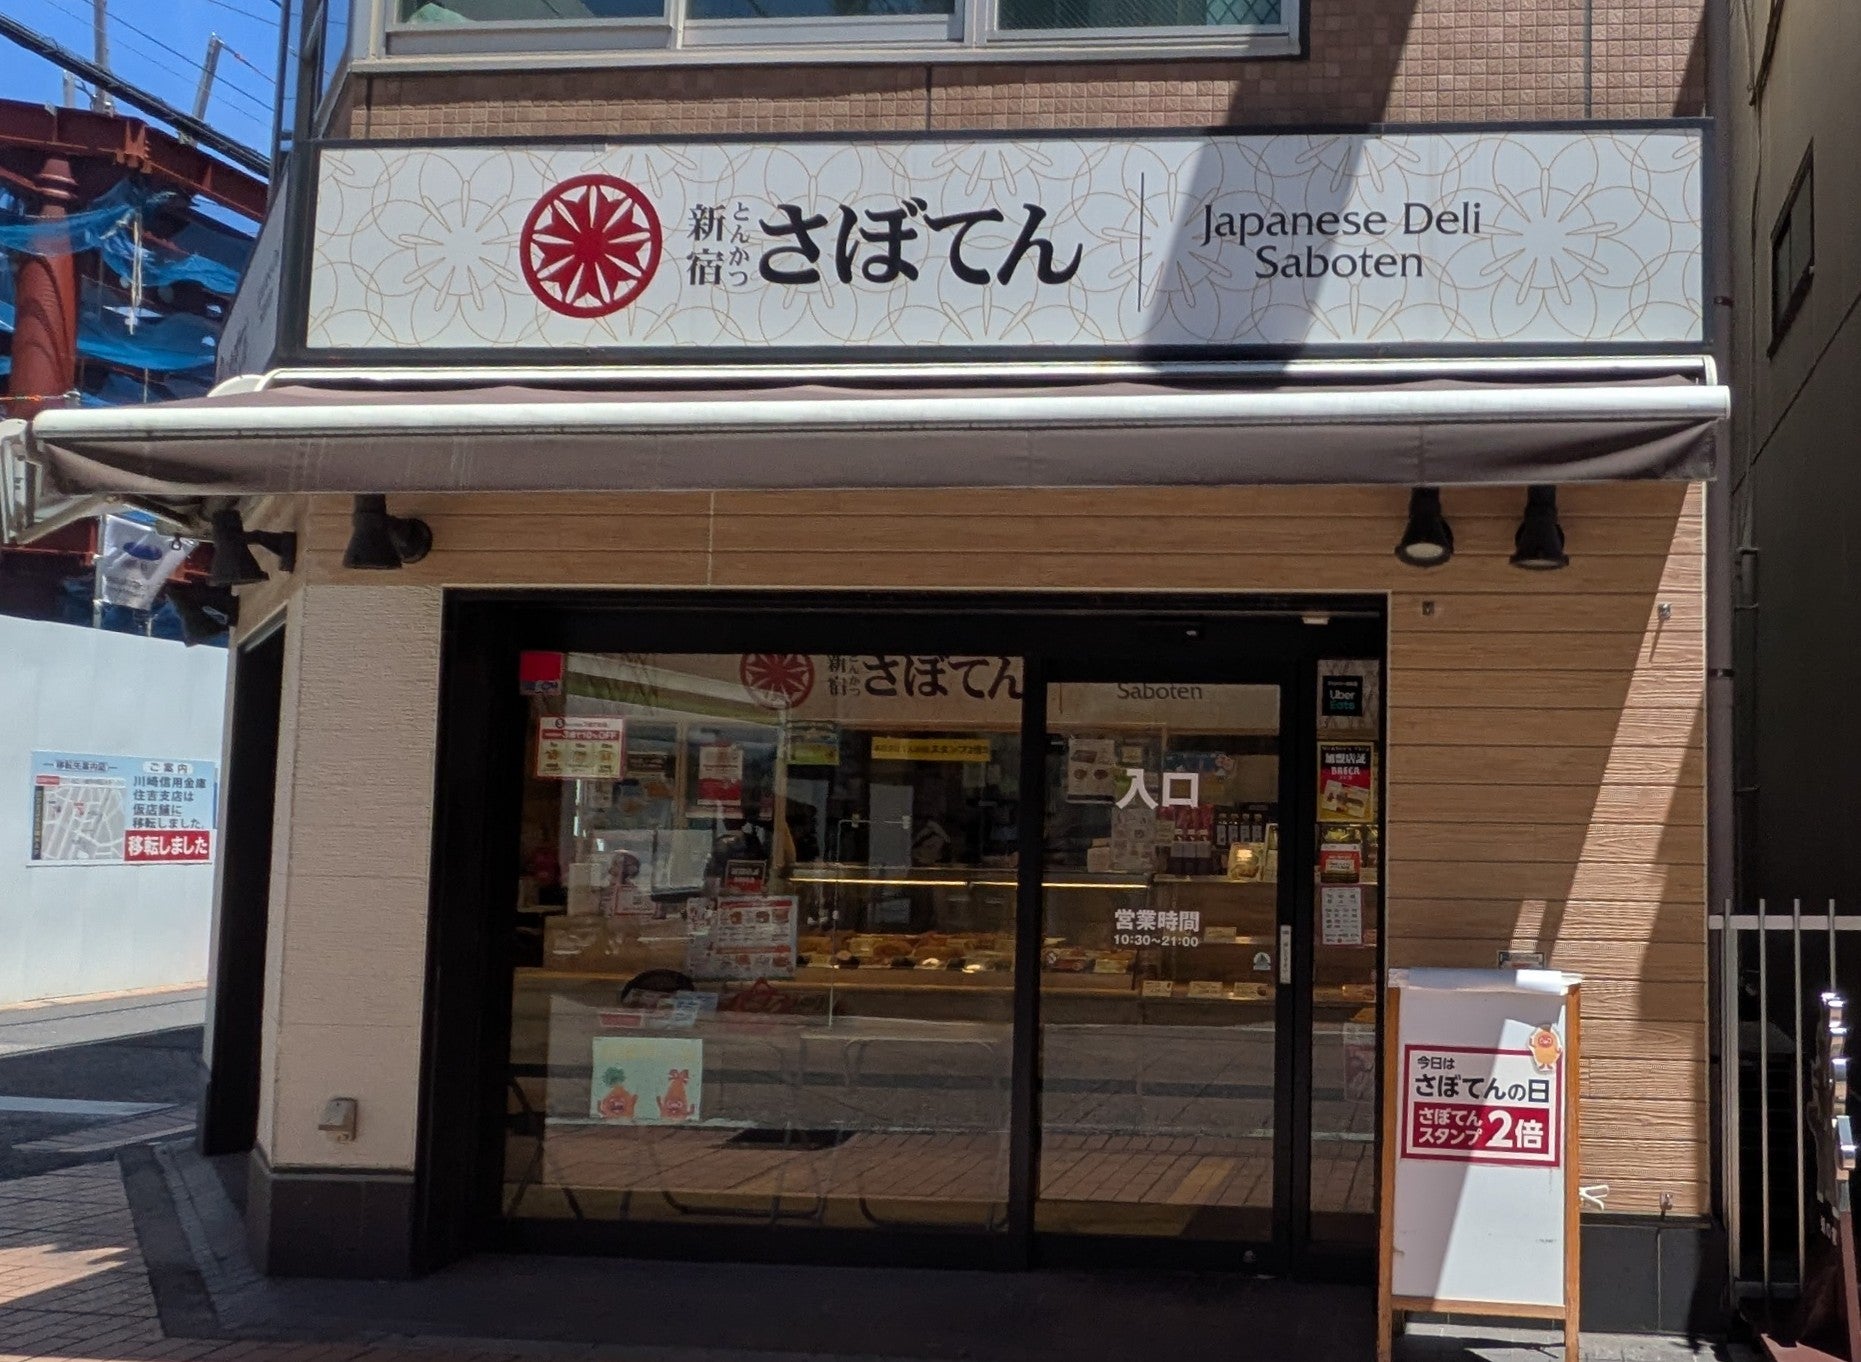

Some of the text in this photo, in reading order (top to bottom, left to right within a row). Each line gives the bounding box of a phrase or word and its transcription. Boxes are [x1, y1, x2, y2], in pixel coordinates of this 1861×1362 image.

[1201, 202, 1481, 246] Japanese Deli
[687, 204, 726, 285] 新宿
[729, 202, 750, 287] とんかつ
[758, 199, 1083, 286] さぼてん
[1255, 245, 1423, 279] Saboten
[863, 655, 1023, 700] さぼてん
[1117, 683, 1203, 700] Saboten
[1116, 768, 1199, 810] 入口
[128, 834, 208, 856] 移転しました
[1114, 908, 1200, 932] 営業時間
[1417, 1055, 1455, 1070] 今日は
[1415, 1073, 1549, 1103] さぼてんの日
[1418, 1107, 1483, 1127] さぼてん
[1485, 1109, 1544, 1149] 2倍
[1418, 1127, 1483, 1146] スタンプ
